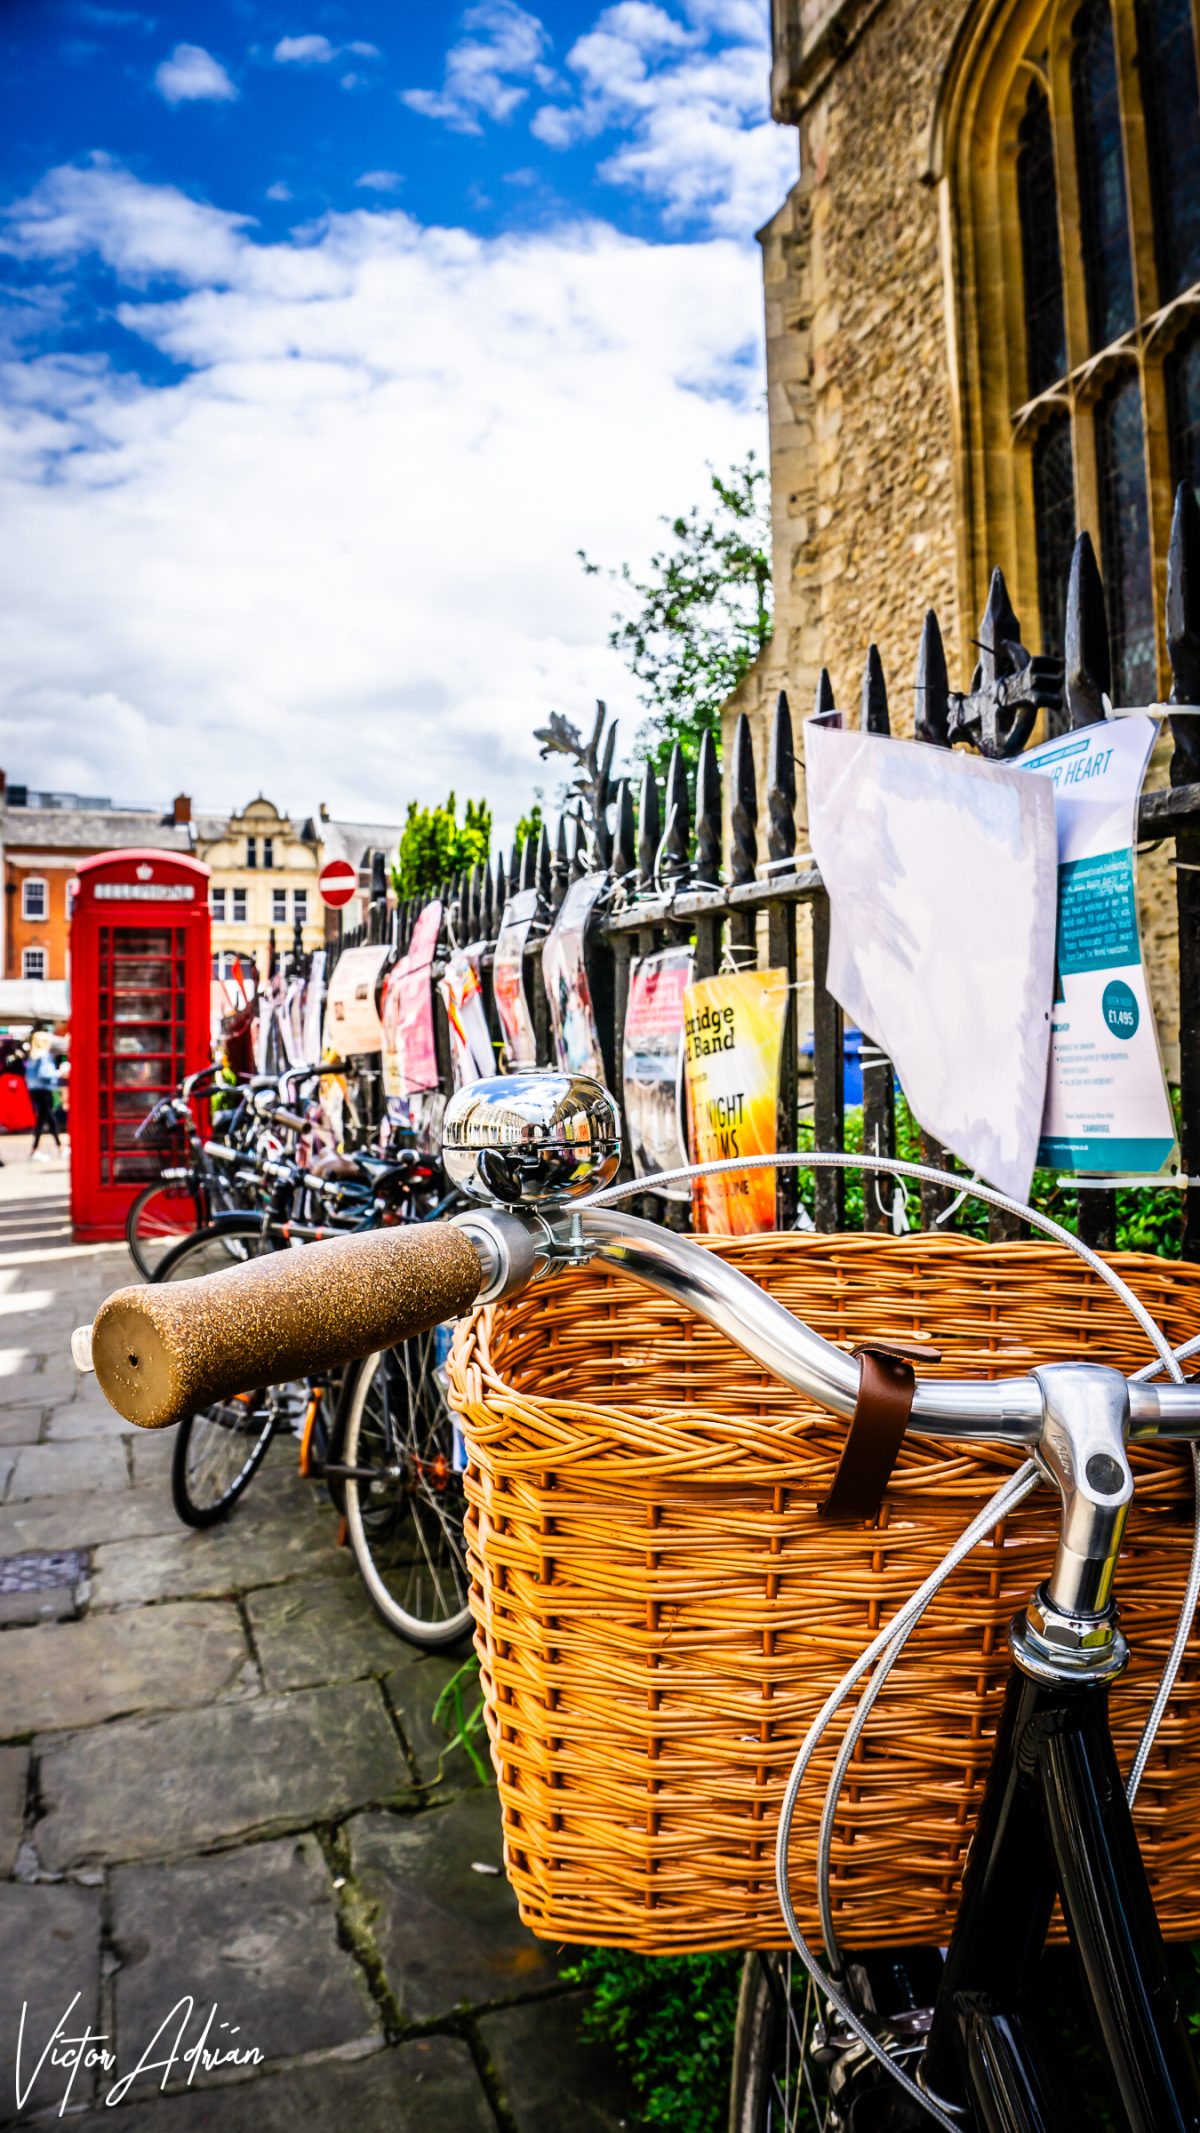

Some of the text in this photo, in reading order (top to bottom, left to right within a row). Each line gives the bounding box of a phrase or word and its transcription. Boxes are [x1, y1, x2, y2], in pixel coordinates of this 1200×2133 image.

[1064, 748, 1115, 785] HEART
[1108, 1009, 1134, 1031] £1,495
[693, 1026, 735, 1058] Band
